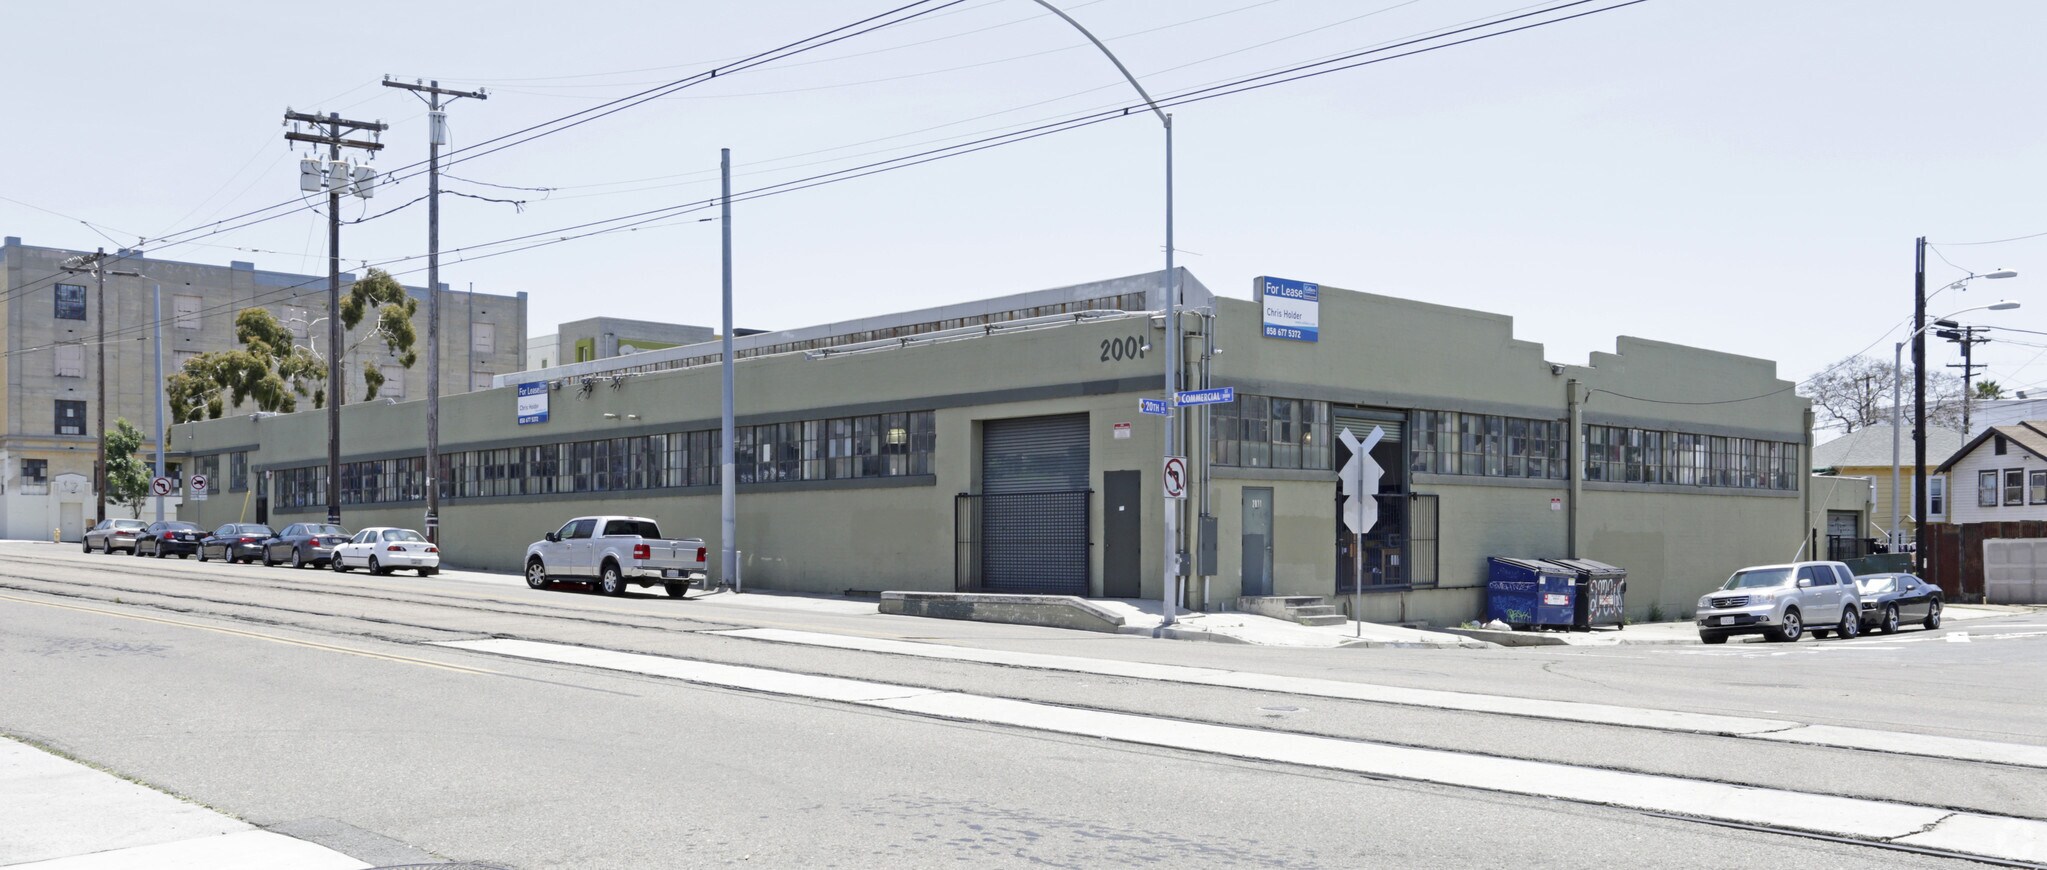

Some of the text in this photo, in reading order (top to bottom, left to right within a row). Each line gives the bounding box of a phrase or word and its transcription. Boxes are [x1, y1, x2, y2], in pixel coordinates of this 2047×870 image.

[1266, 282, 1279, 295] For
[1281, 284, 1303, 298] Lease
[1266, 307, 1302, 320] Chris Holder
[1277, 328, 1287, 337] 677
[1288, 329, 1301, 339] 5372
[1100, 335, 1145, 362] 2001
[519, 387, 540, 396] For Lease
[1181, 392, 1220, 403] COMMERCIAL
[1146, 401, 1159, 412] 20TH
